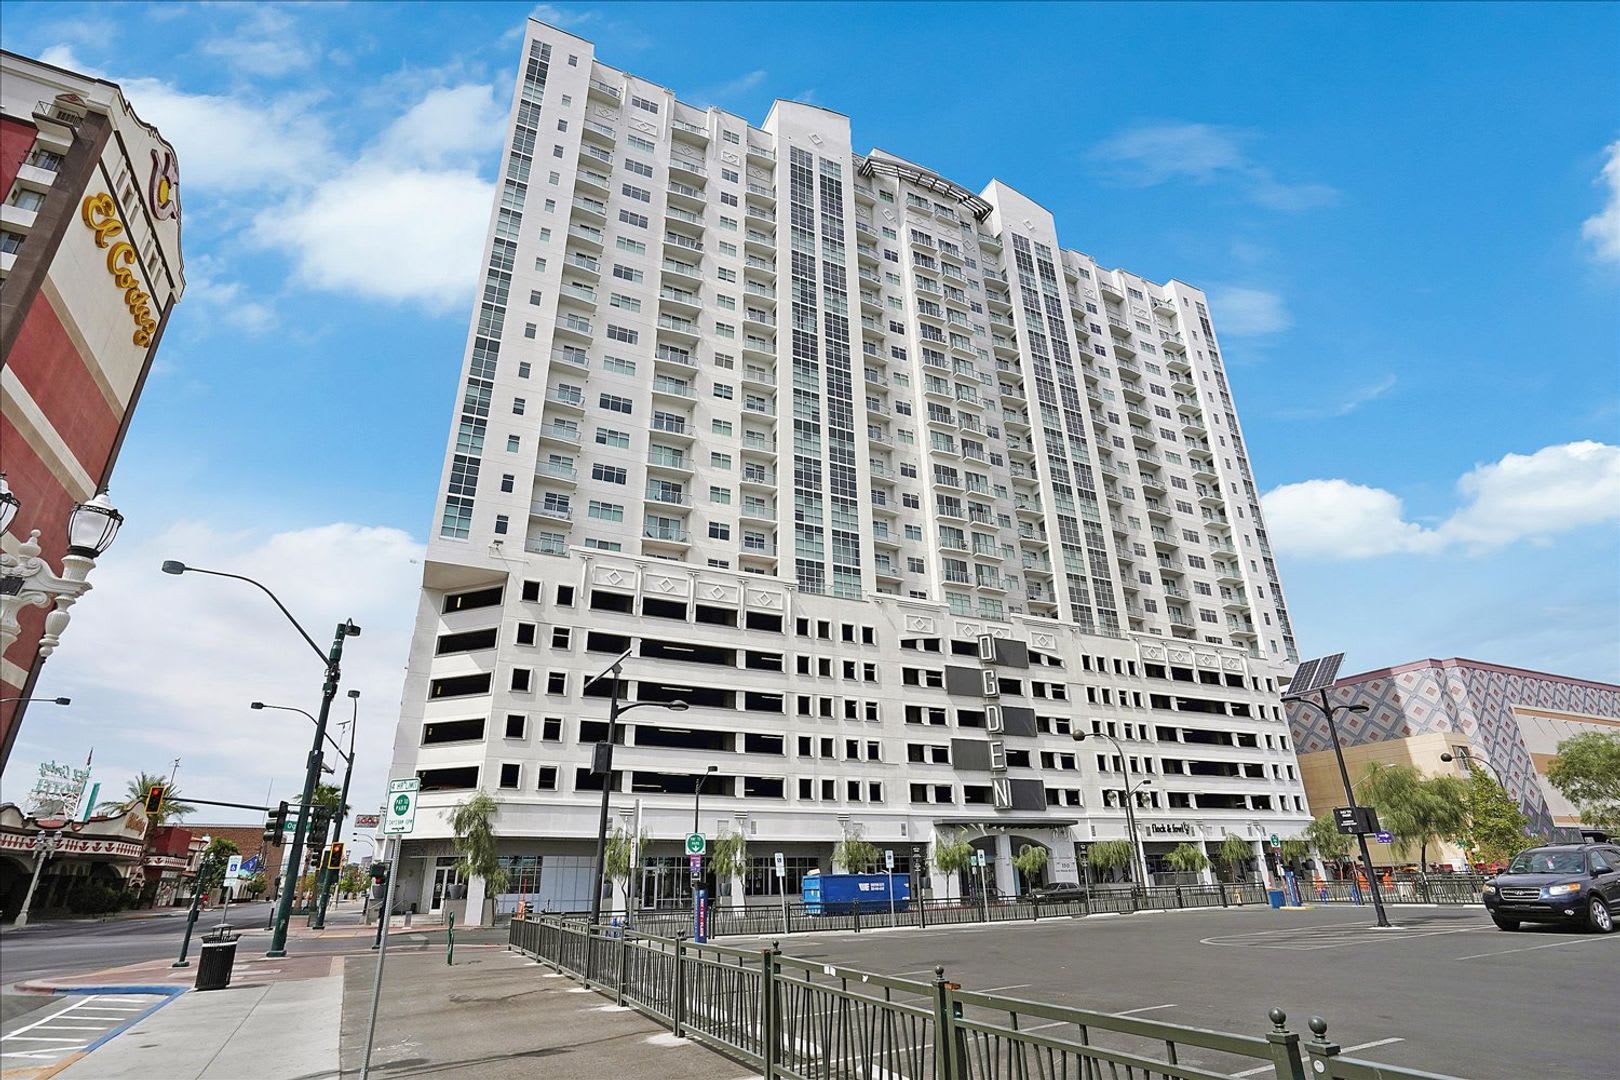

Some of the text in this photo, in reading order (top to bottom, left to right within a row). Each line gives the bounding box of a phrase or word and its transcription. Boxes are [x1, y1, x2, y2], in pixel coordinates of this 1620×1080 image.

[82, 192, 157, 348] El Cortez
[979, 635, 1012, 807] OGDEN
